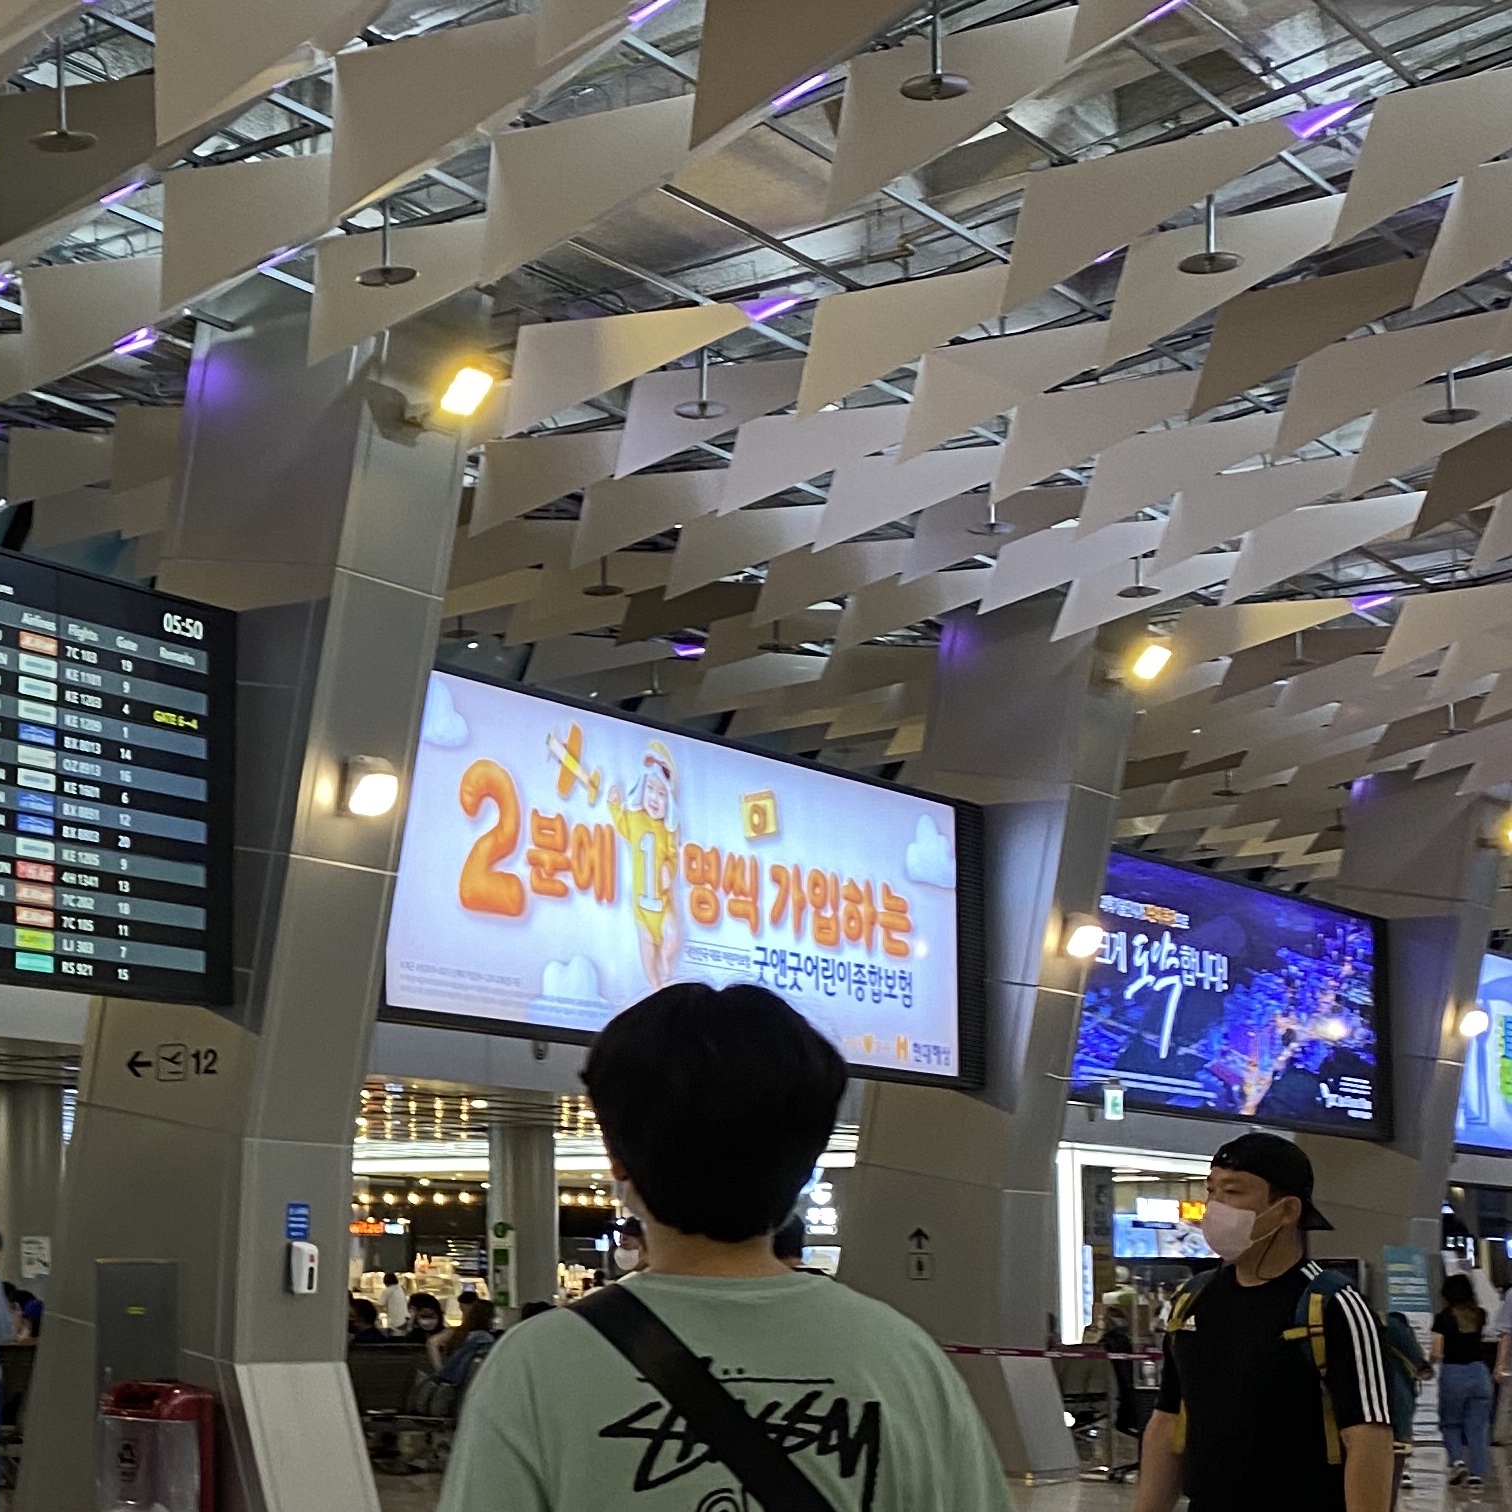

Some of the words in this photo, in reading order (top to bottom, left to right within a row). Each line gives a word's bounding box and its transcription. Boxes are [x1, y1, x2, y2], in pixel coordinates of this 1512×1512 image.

[163, 612, 204, 640] 05:50
[122, 703, 130, 715] 4
[122, 727, 129, 739] 1
[119, 748, 132, 761] 14
[121, 792, 129, 804] 6
[118, 880, 130, 893] 13
[769, 863, 913, 959] 가입하는
[118, 924, 129, 937] 11
[120, 946, 127, 959] 7
[117, 968, 129, 981] 15
[190, 1049, 218, 1075] 12
